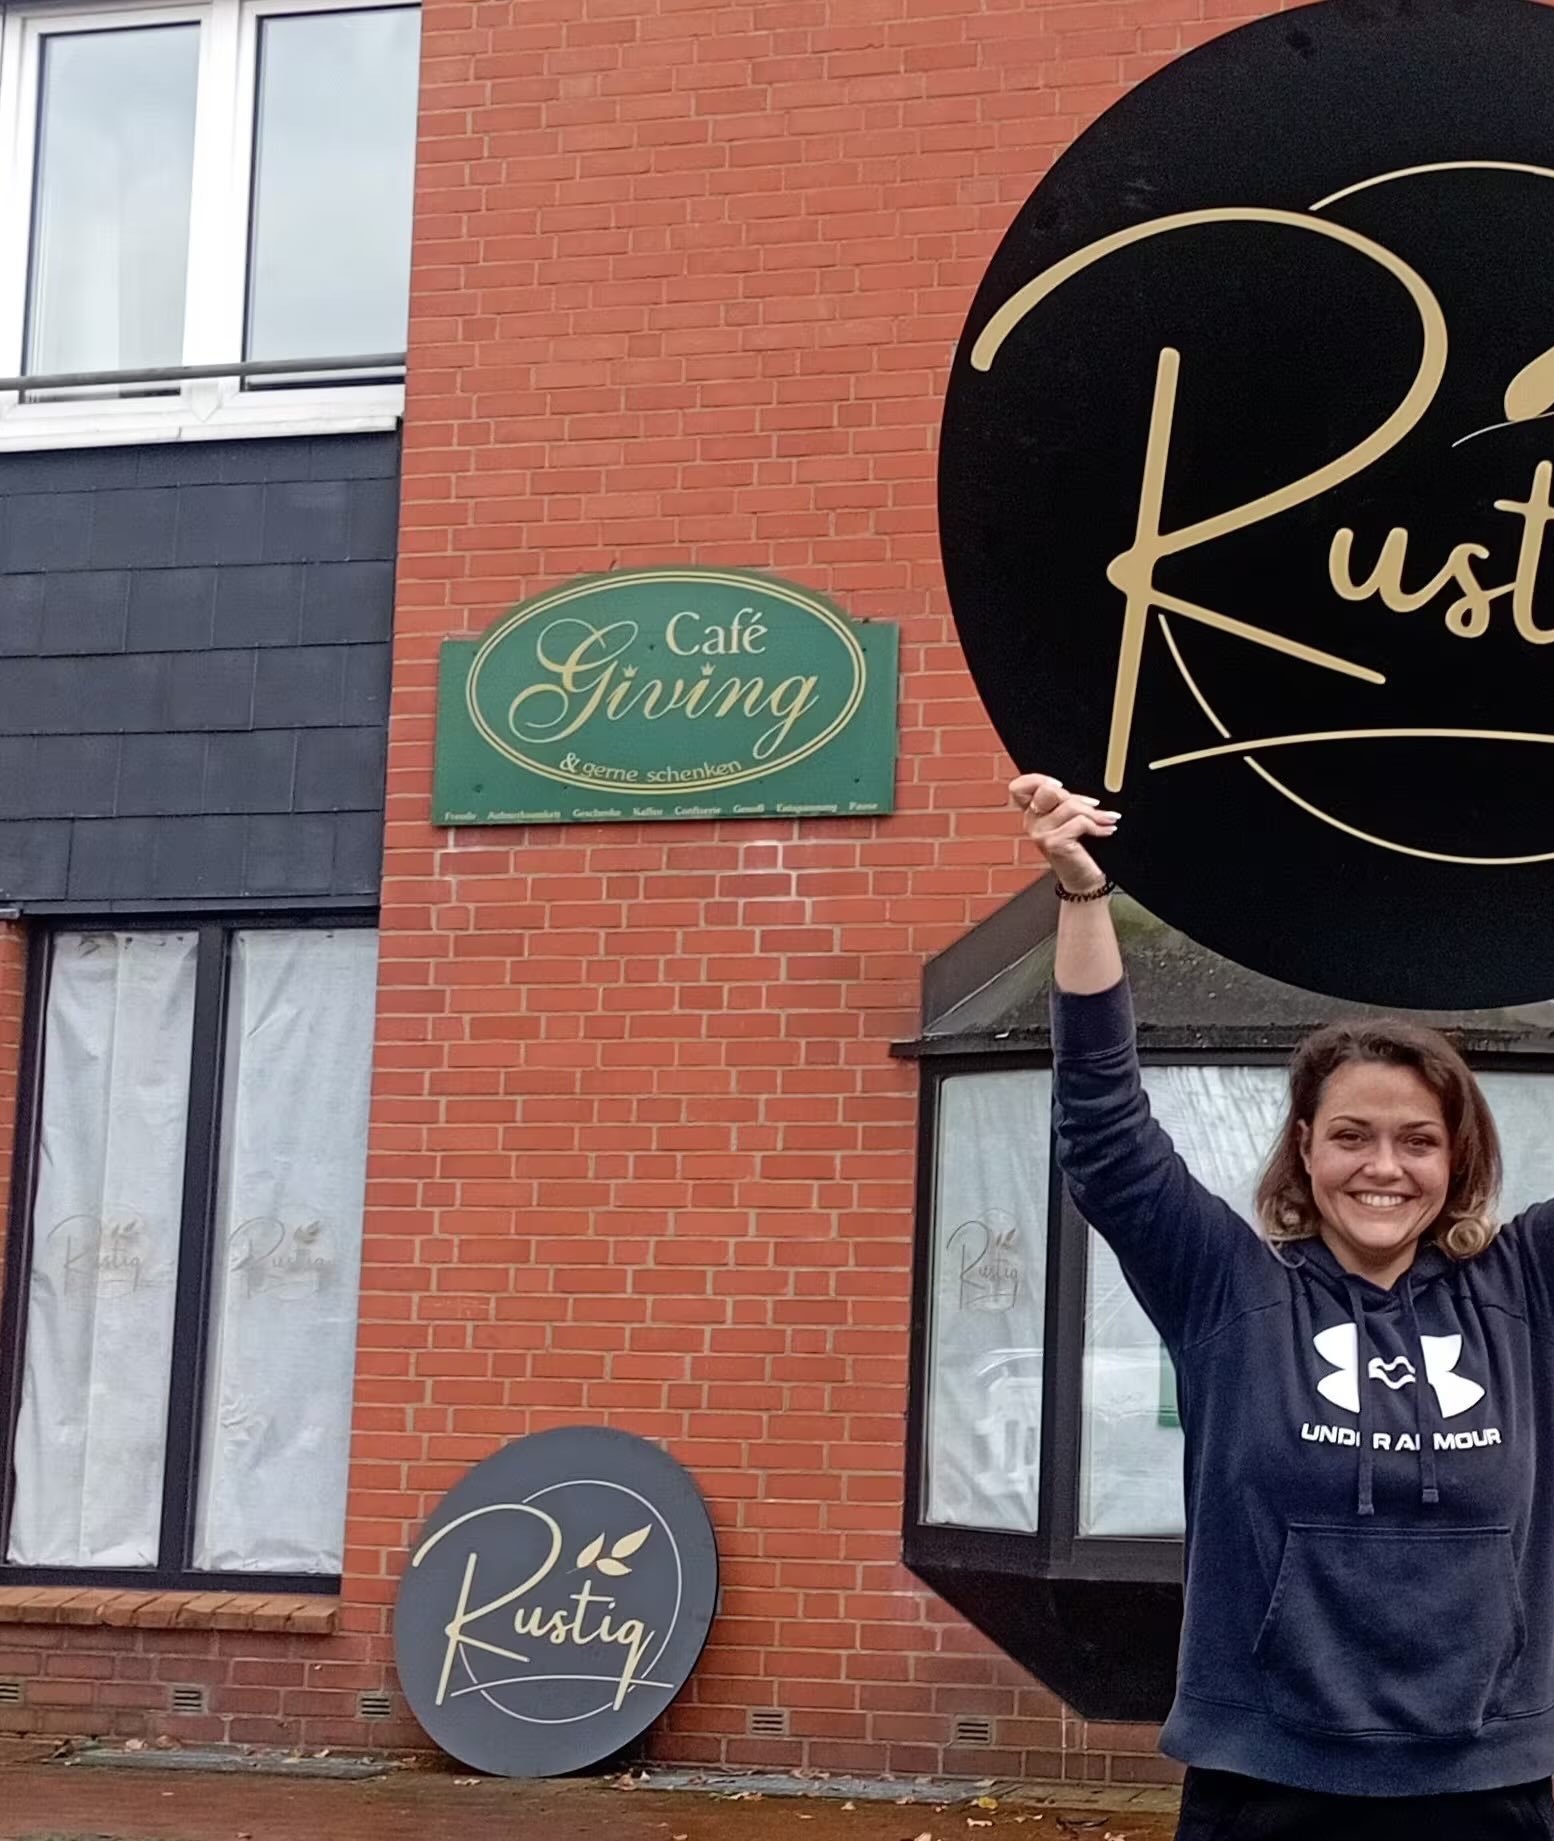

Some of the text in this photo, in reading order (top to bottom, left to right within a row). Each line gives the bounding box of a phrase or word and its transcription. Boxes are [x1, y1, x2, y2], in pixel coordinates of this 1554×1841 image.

[666, 608, 768, 657] Café
[509, 617, 819, 760] Giving
[559, 752, 742, 785] & gerne schenken
[411, 1502, 656, 1712] Rustiq
